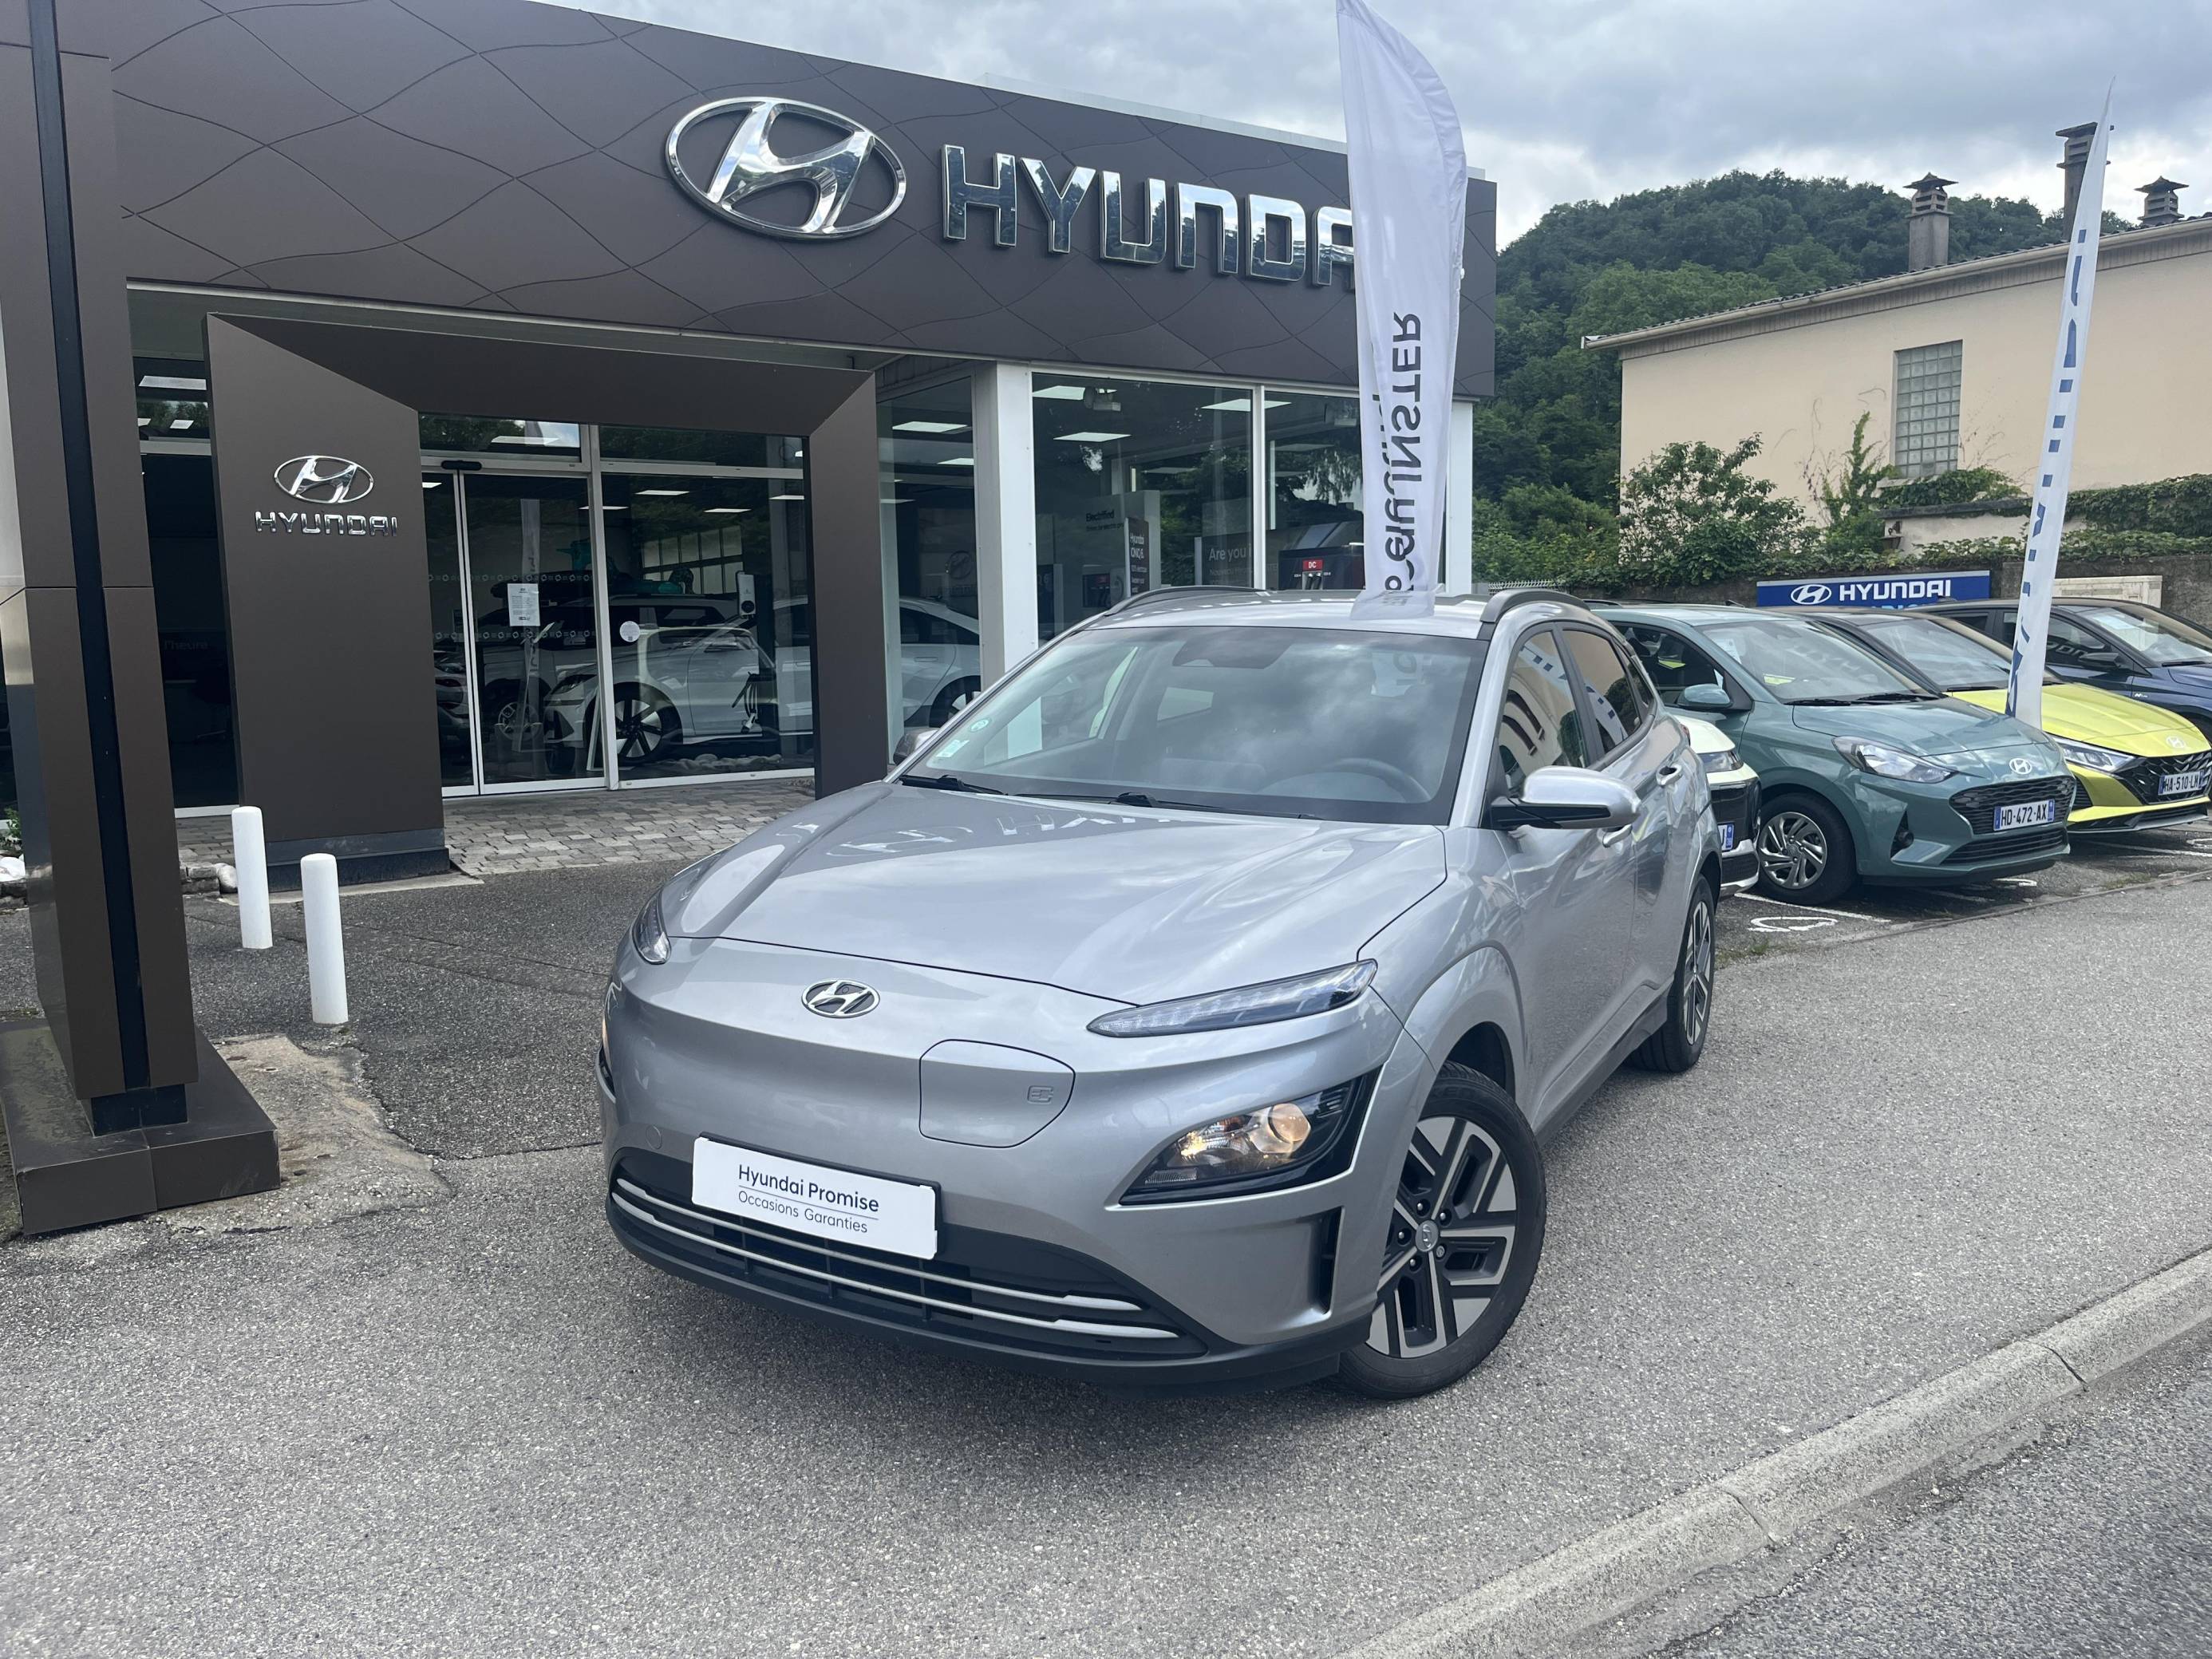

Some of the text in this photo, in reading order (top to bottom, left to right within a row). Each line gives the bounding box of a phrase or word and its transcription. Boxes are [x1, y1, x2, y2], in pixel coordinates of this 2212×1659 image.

[940, 144, 1355, 290] HYUNDA
[255, 511, 398, 537] HYUNDAI
[1209, 548, 1226, 561] Are
[1228, 547, 1246, 563] you
[1839, 579, 1951, 601] HYUNDAI
[2001, 804, 2047, 826] HD-472-AX
[739, 1164, 879, 1212] Hyundai Promise
[738, 1190, 868, 1234] Occasions Garanties
